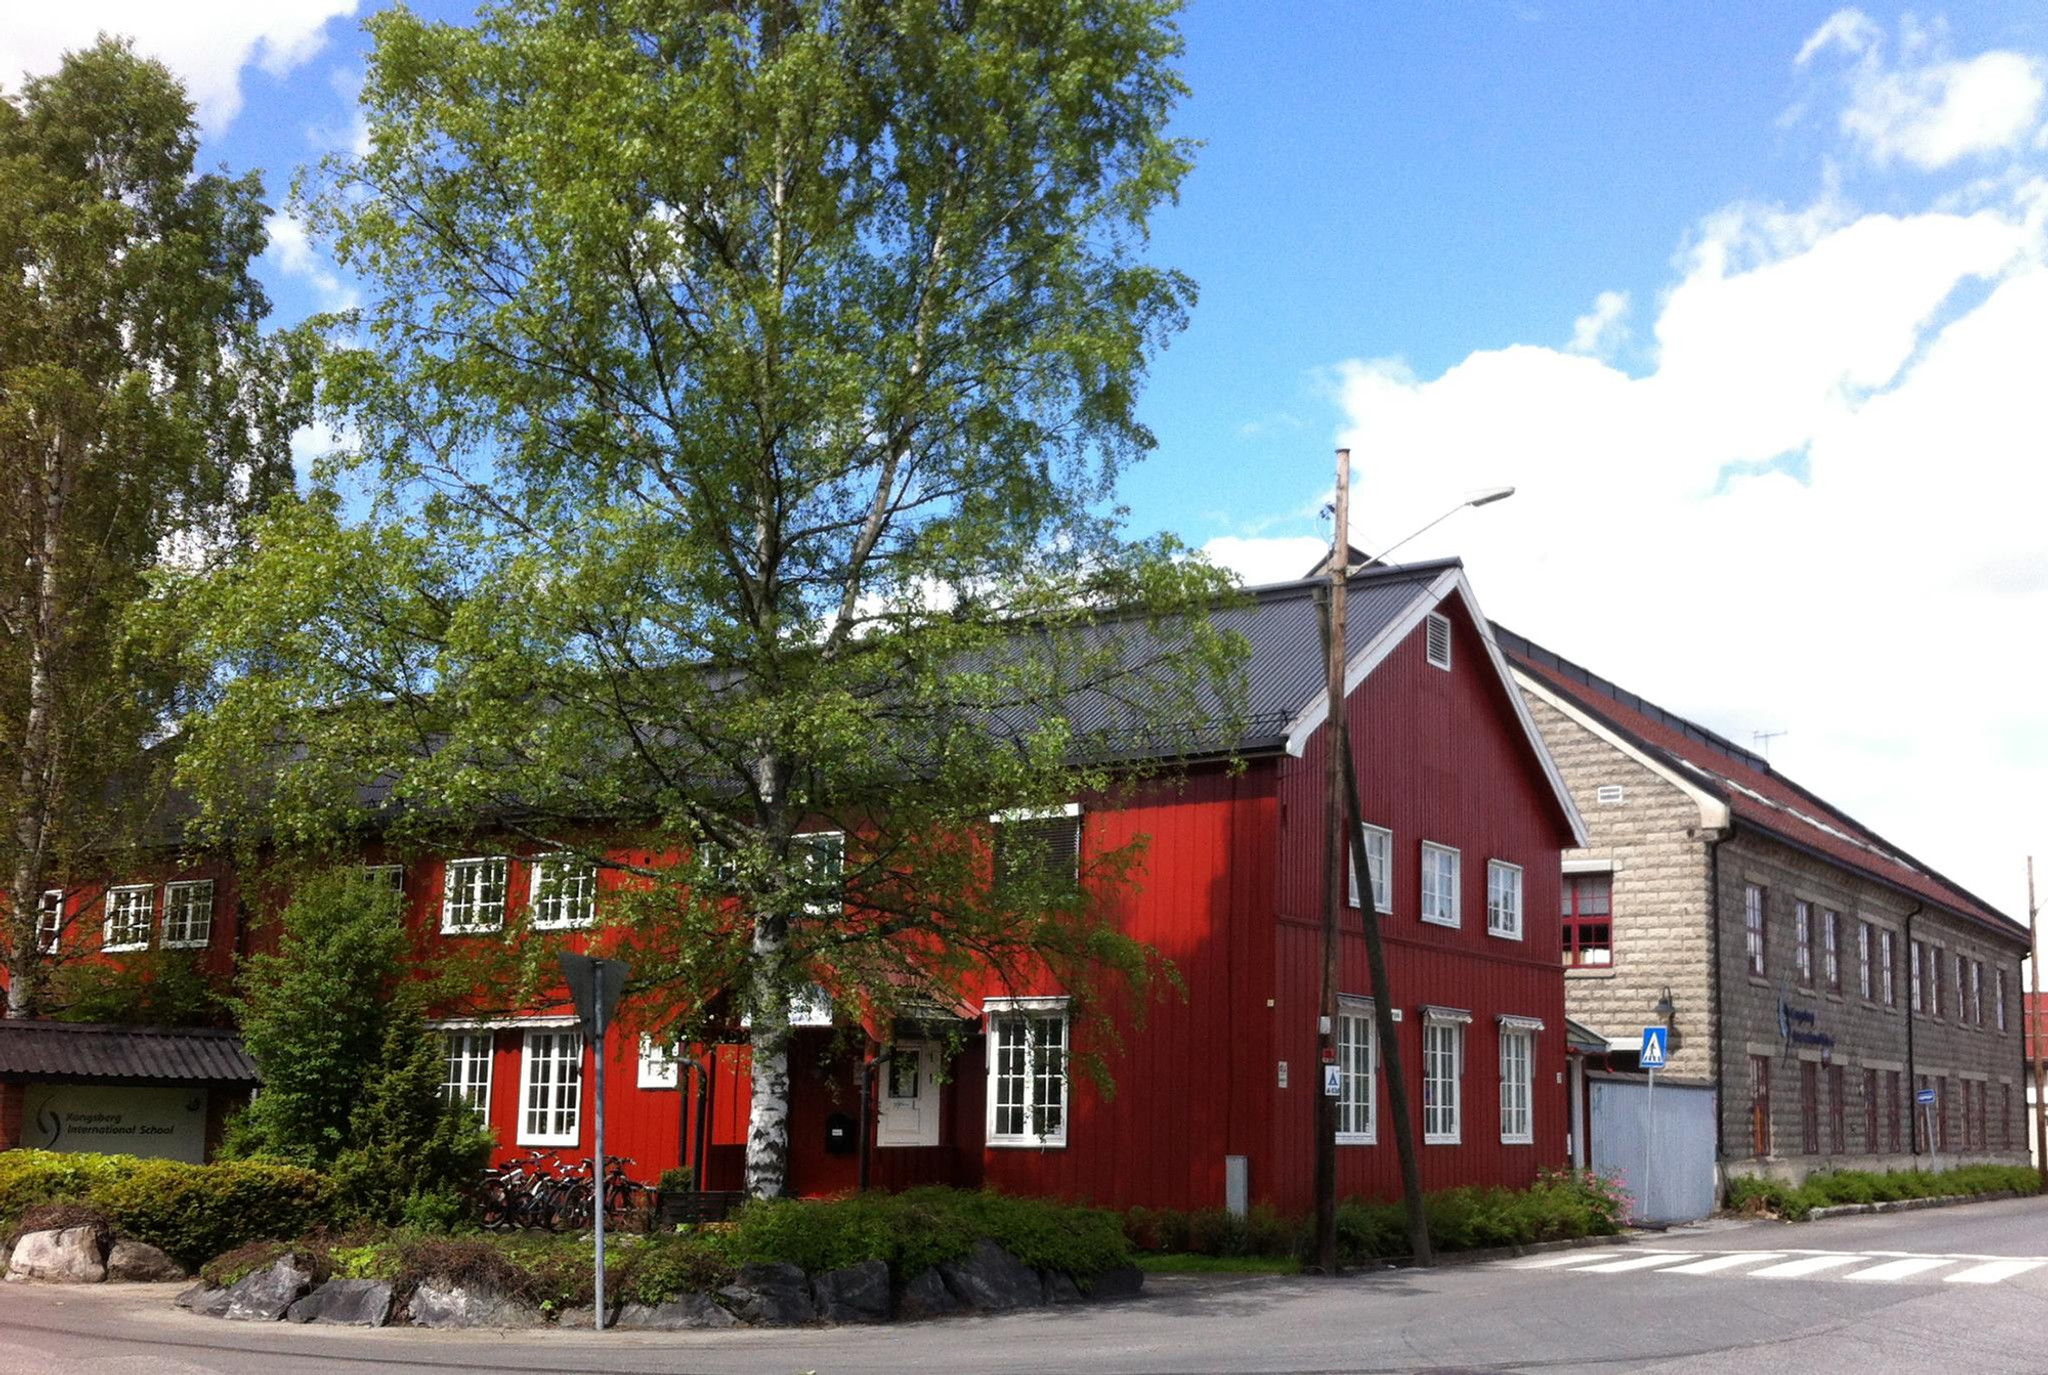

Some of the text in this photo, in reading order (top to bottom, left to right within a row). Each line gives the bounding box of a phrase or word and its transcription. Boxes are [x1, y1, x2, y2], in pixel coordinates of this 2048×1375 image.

[66, 1113, 122, 1124] Kongsberg
[67, 1125, 175, 1135] International School
